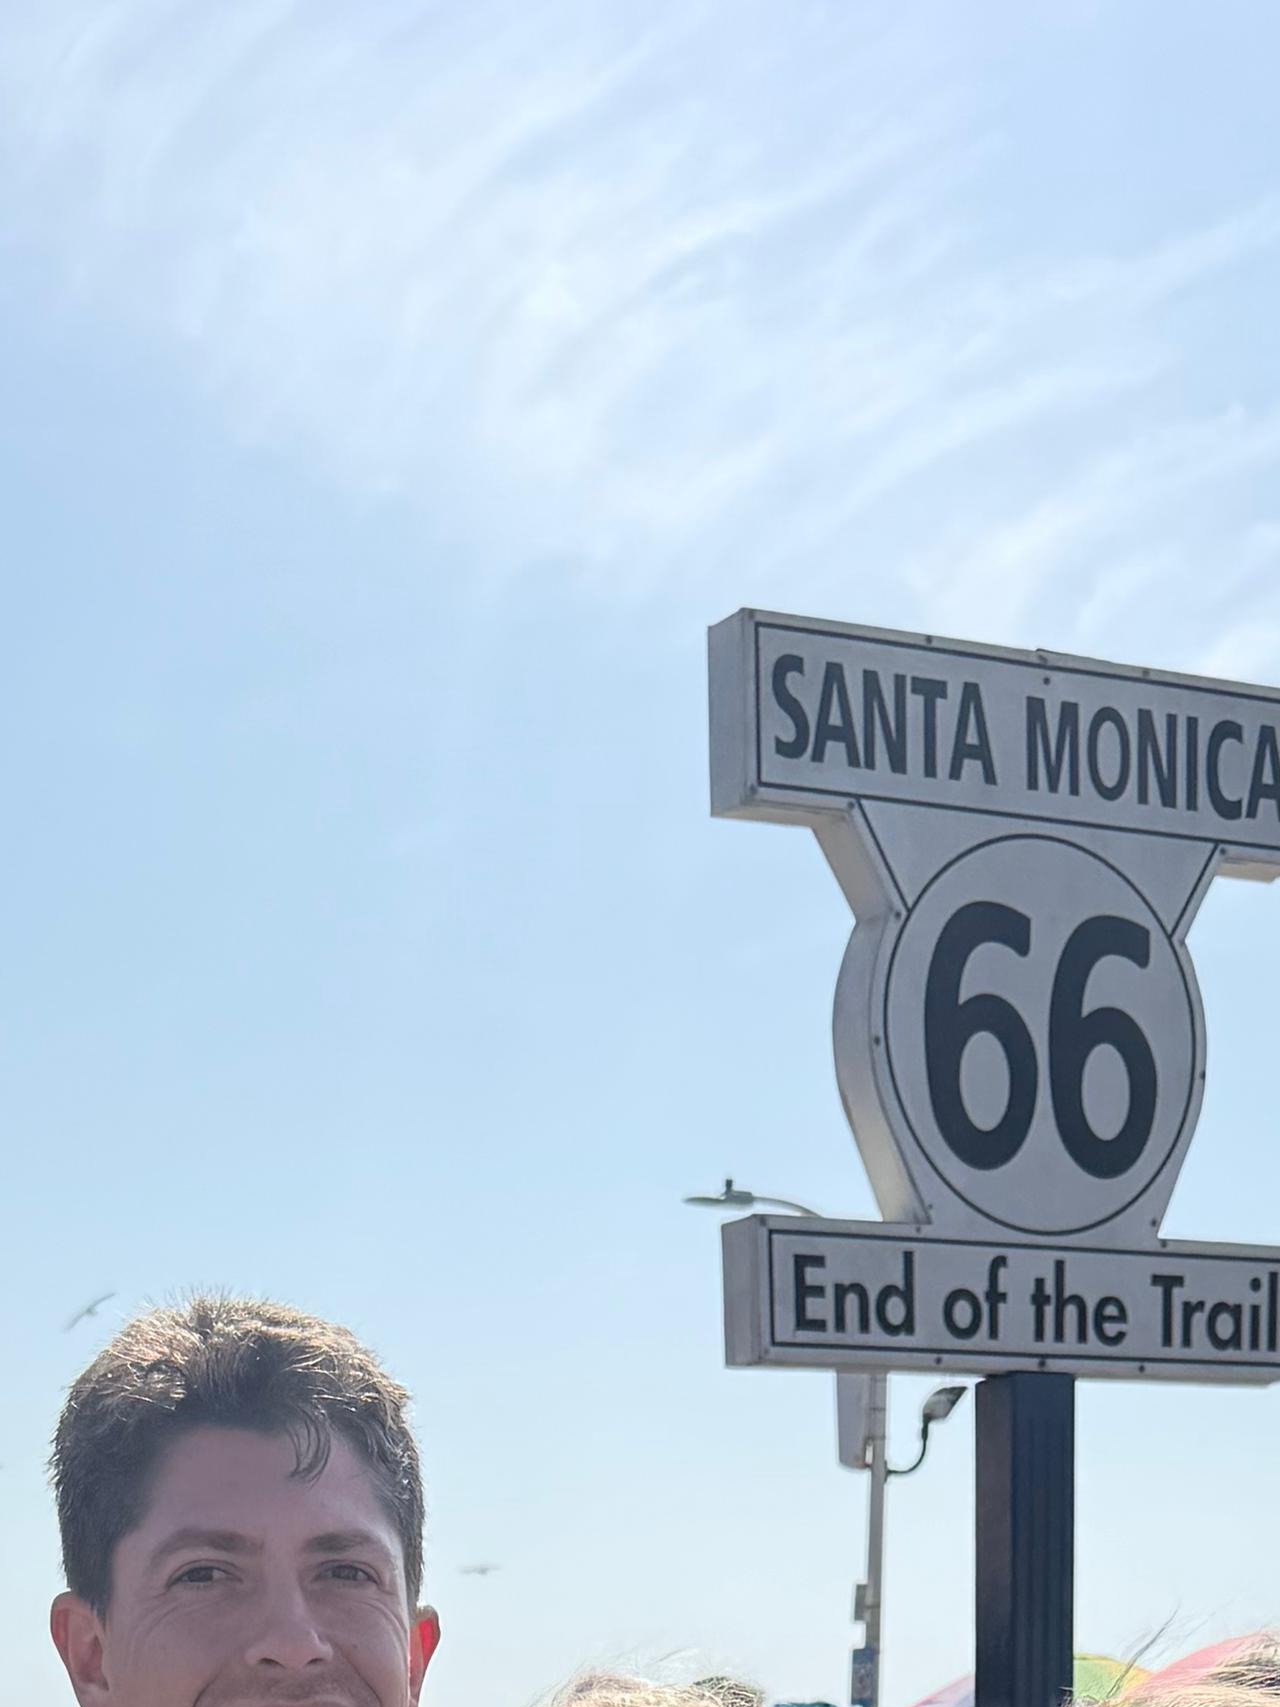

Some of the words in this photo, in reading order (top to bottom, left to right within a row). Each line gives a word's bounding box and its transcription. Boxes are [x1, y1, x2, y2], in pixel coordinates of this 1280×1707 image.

[771, 653, 998, 786] SANTA
[923, 900, 1159, 1180] 66
[792, 1251, 916, 1336] End
[942, 1255, 1008, 1341] of
[1030, 1260, 1129, 1347] the
[1151, 1271, 1279, 1353] Trail
